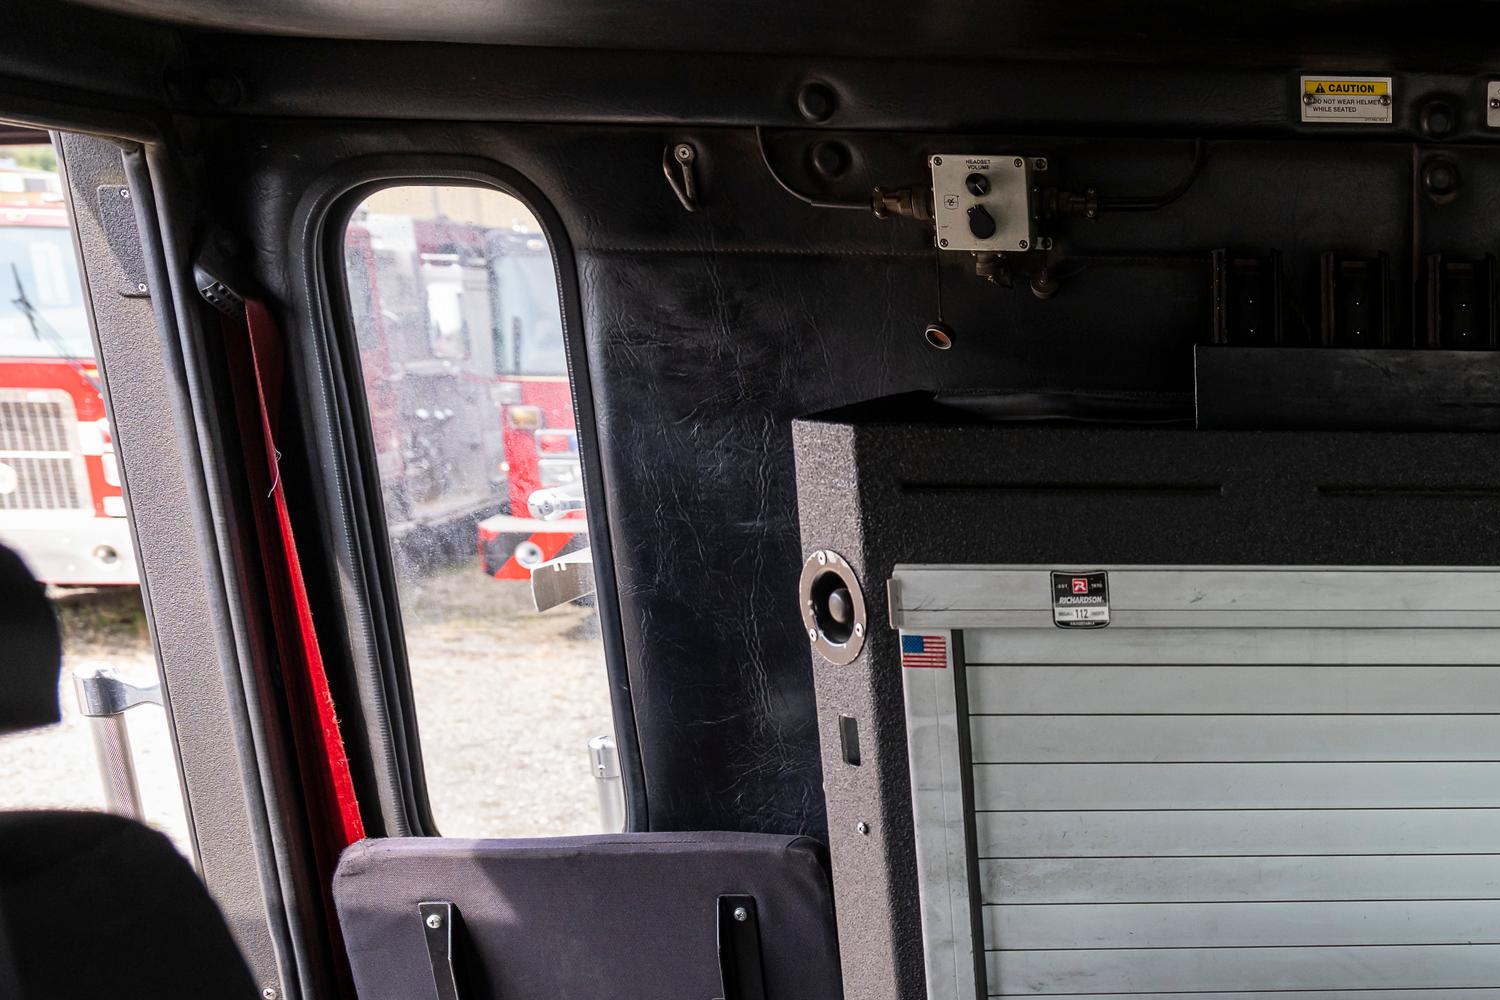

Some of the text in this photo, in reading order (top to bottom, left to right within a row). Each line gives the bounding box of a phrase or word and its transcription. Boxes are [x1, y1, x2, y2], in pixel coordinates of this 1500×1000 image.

[1328, 84, 1375, 93] CAUTION
[1058, 596, 1102, 604] RICHARDSON
[1075, 609, 1089, 619] 112
